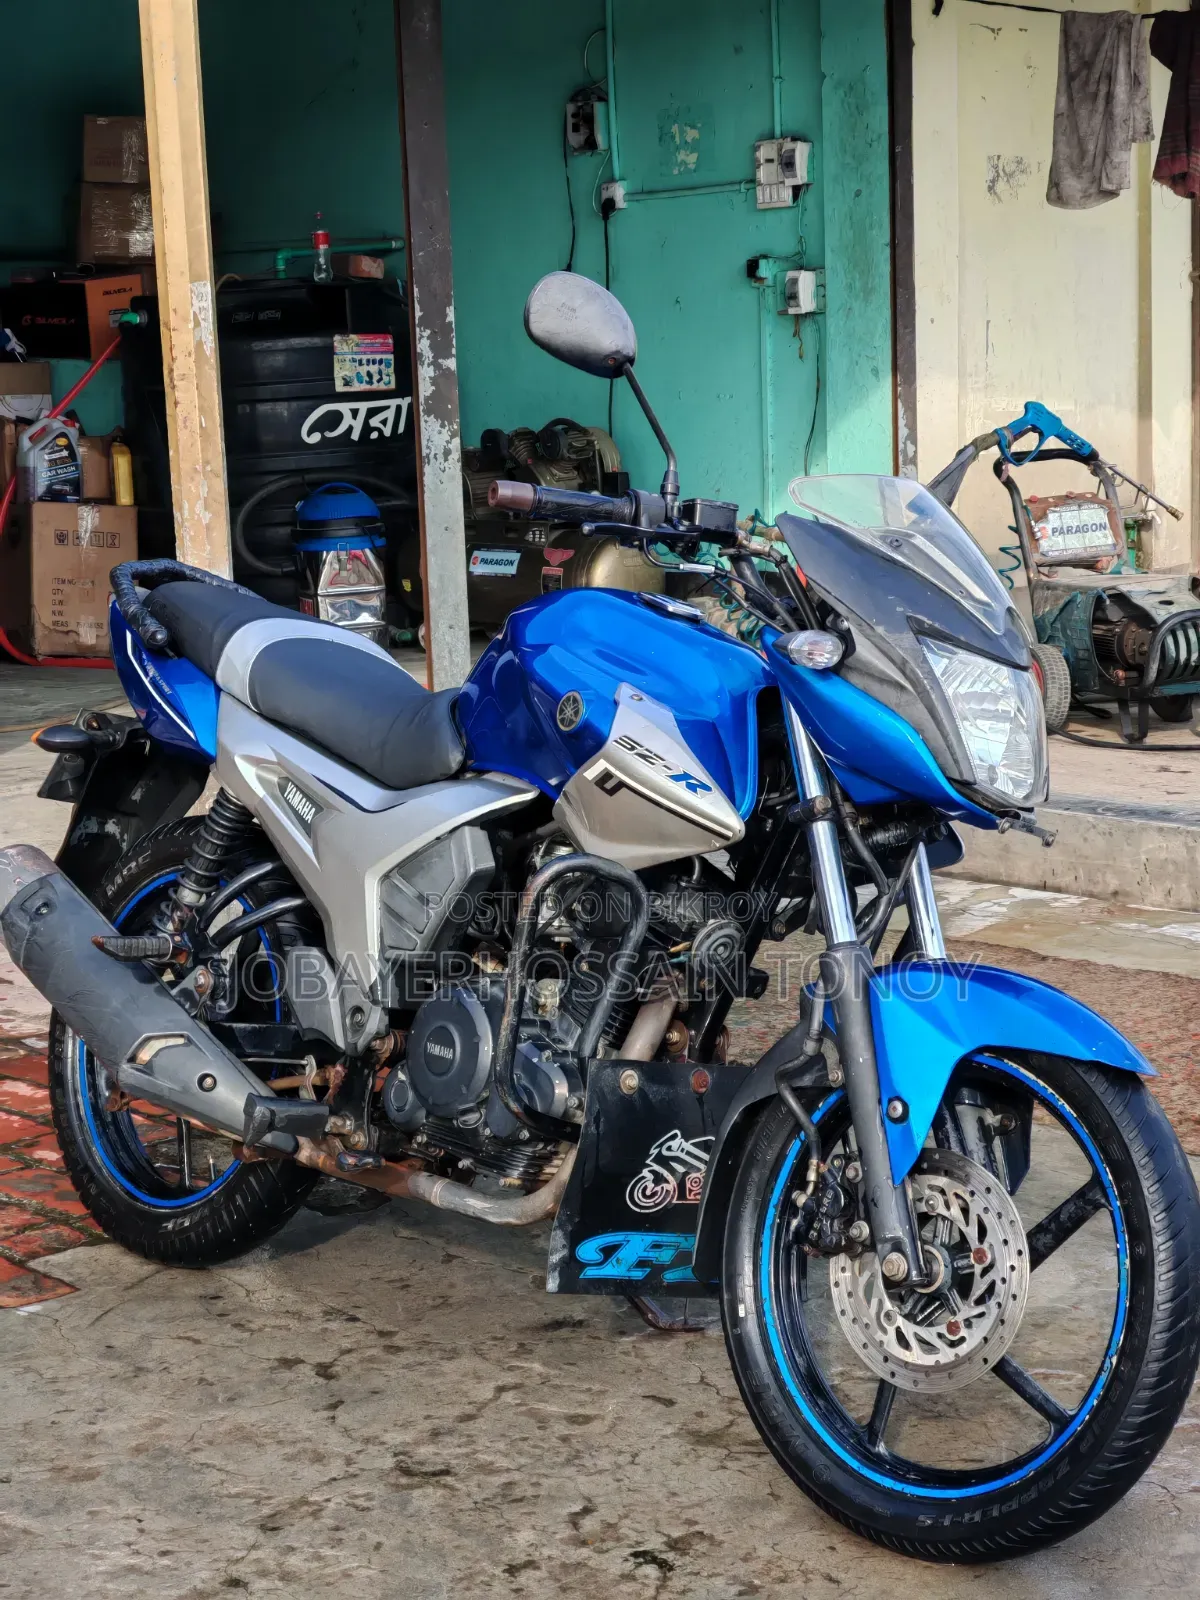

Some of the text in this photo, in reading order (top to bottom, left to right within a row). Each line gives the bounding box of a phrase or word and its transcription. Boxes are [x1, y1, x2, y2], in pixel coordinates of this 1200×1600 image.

[41, 465, 76, 478] CAR WASH
[1051, 522, 1107, 537] PARAGON
[479, 557, 515, 567] PARAGON
[611, 735, 714, 799] SZ-R
[283, 781, 316, 824] YAMAHA
[426, 1041, 454, 1060] YAMAHA
